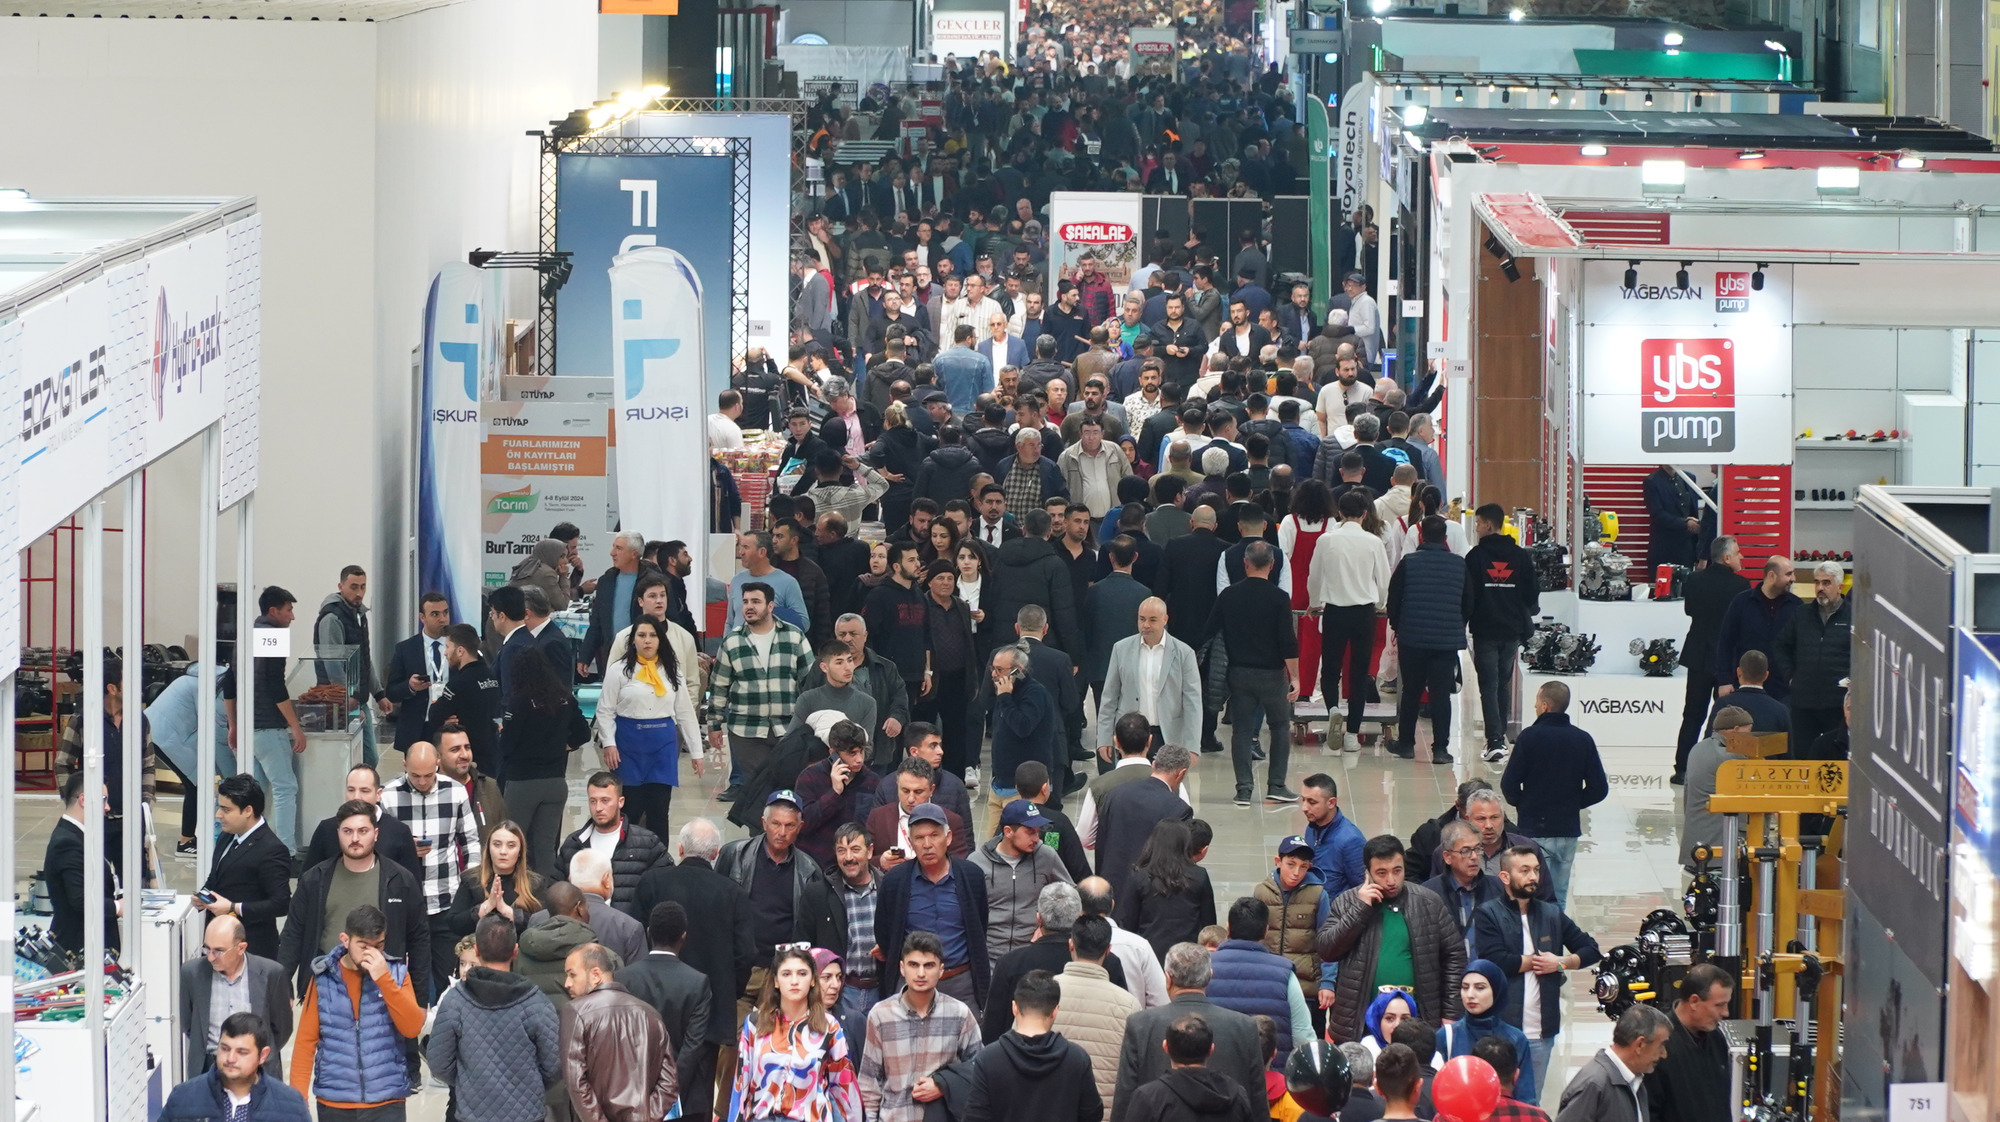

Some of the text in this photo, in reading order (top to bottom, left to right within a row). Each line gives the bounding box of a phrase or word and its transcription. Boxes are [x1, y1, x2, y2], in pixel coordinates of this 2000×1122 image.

[937, 19, 1001, 32] GENÇLER
[1065, 225, 1127, 241] ŞAKALAK
[1719, 273, 1745, 296] ybs
[1619, 283, 1702, 300] YAĞBASAN
[1719, 299, 1745, 312] pump
[1653, 342, 1722, 403] ybs
[529, 391, 555, 399] TÜYAP
[501, 417, 529, 426] TÜYAP
[1653, 416, 1722, 447] pump
[503, 440, 580, 449] FUARLARIMIZIN
[507, 449, 576, 460] ÖN KAYITLARI
[508, 463, 575, 473] BAŞLAMIŞTIR
[495, 499, 529, 511] Tarım
[522, 534, 540, 543] 2024
[262, 637, 277, 646] 759
[1580, 697, 1664, 714] YAĞBASAN
[1874, 628, 1943, 794] UYSAL
[1870, 787, 1943, 901] HYDRAULIC
[1909, 1097, 1931, 1111] 751
